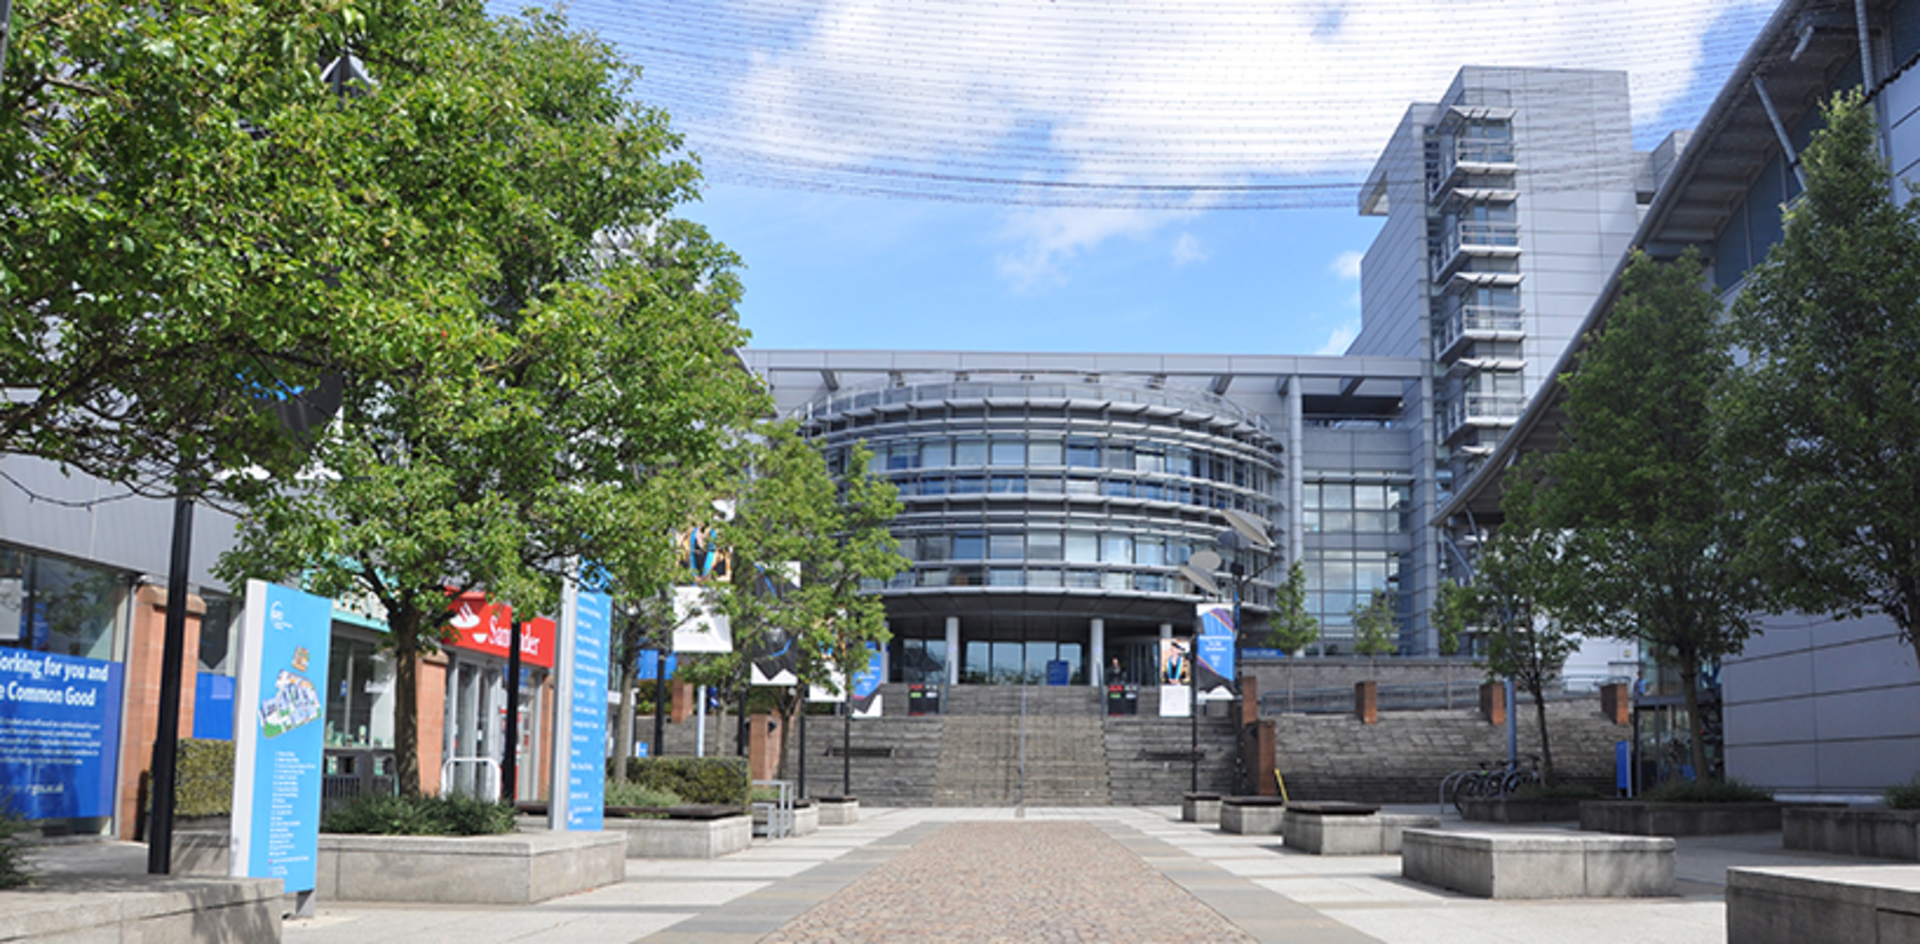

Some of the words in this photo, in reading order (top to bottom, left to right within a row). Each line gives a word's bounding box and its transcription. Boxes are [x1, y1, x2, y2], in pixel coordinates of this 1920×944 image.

[0, 651, 42, 679] orking
[44, 656, 62, 677] for
[63, 664, 86, 682] you
[87, 663, 109, 682] and
[7, 680, 63, 704] Common
[65, 686, 97, 707] Good
